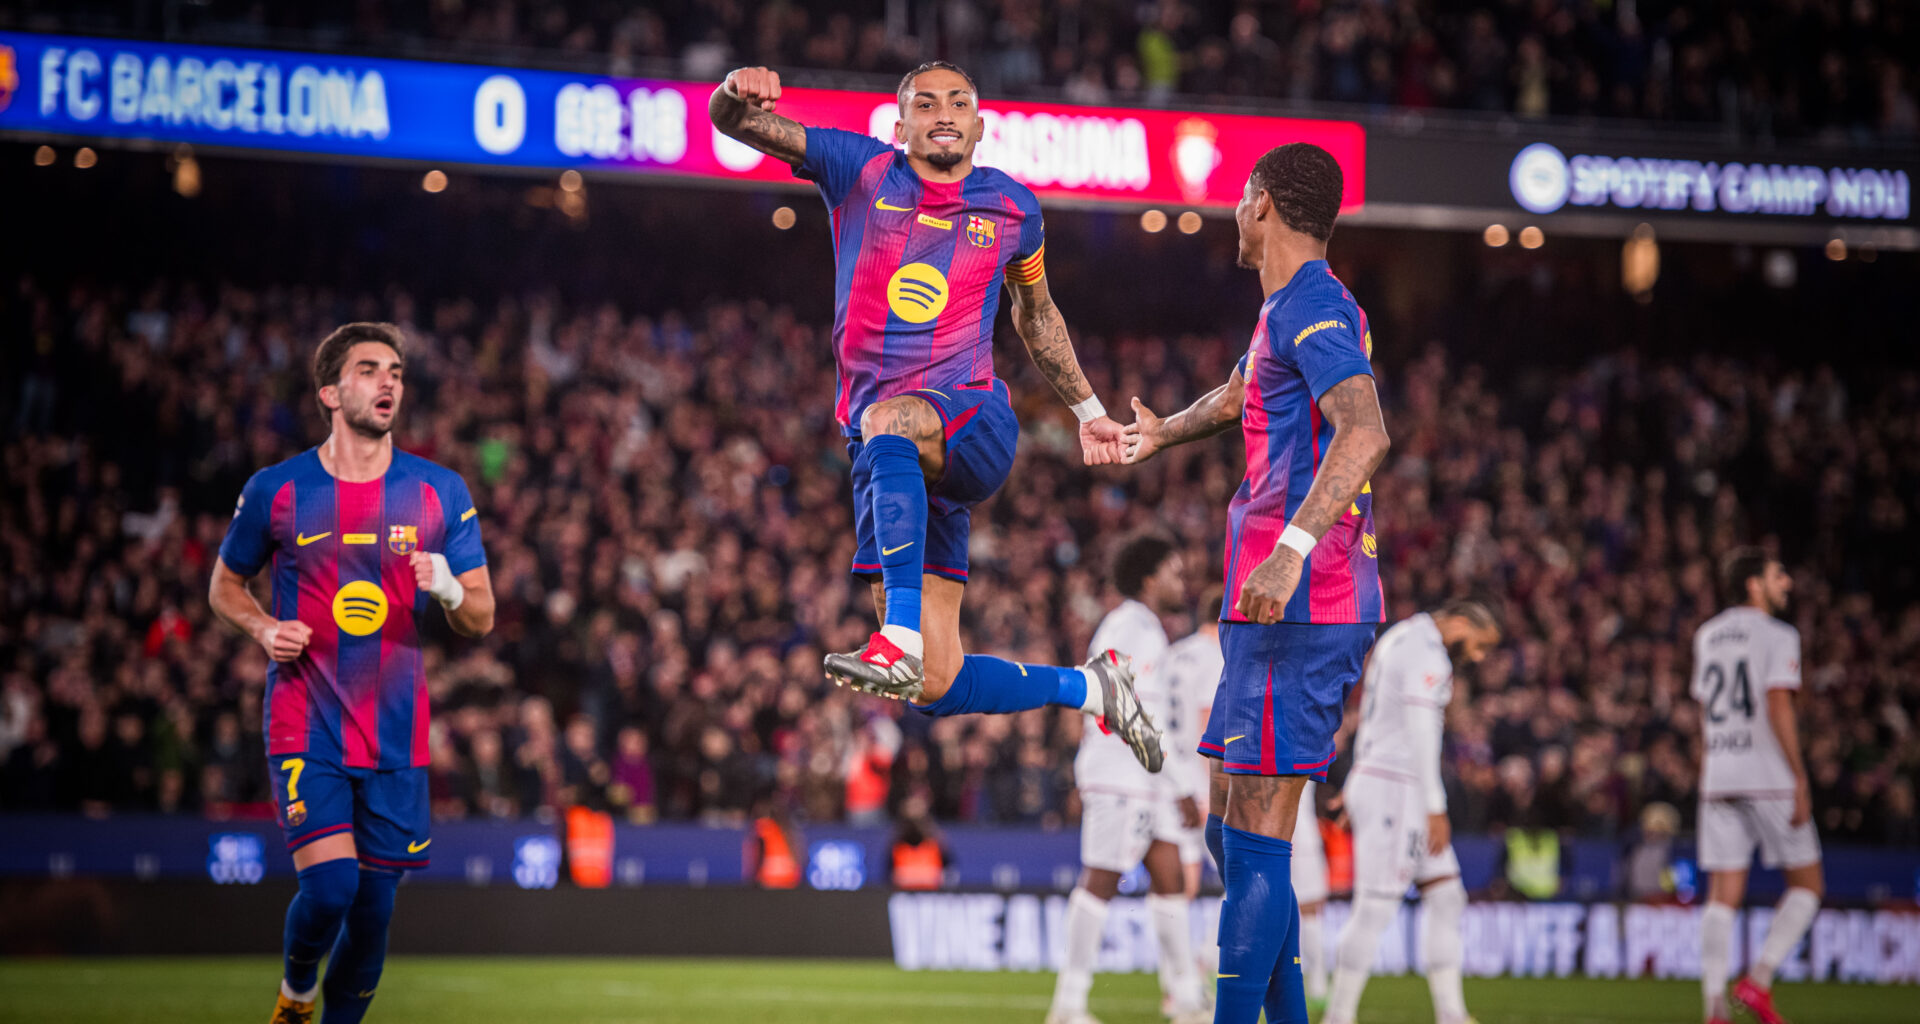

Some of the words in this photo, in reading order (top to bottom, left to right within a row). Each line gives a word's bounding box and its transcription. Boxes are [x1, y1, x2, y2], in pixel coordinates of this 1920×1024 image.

[39, 48, 101, 121] FC
[111, 52, 390, 142] BARCELONA
[474, 74, 527, 155] 0
[1567, 154, 1719, 211] SPOTIFY
[1719, 162, 1829, 216] CAMP
[1826, 167, 1910, 219] NOU
[1293, 320, 1338, 347] AMBILIGHT
[1703, 660, 1754, 723] 24
[281, 757, 306, 801] 7
